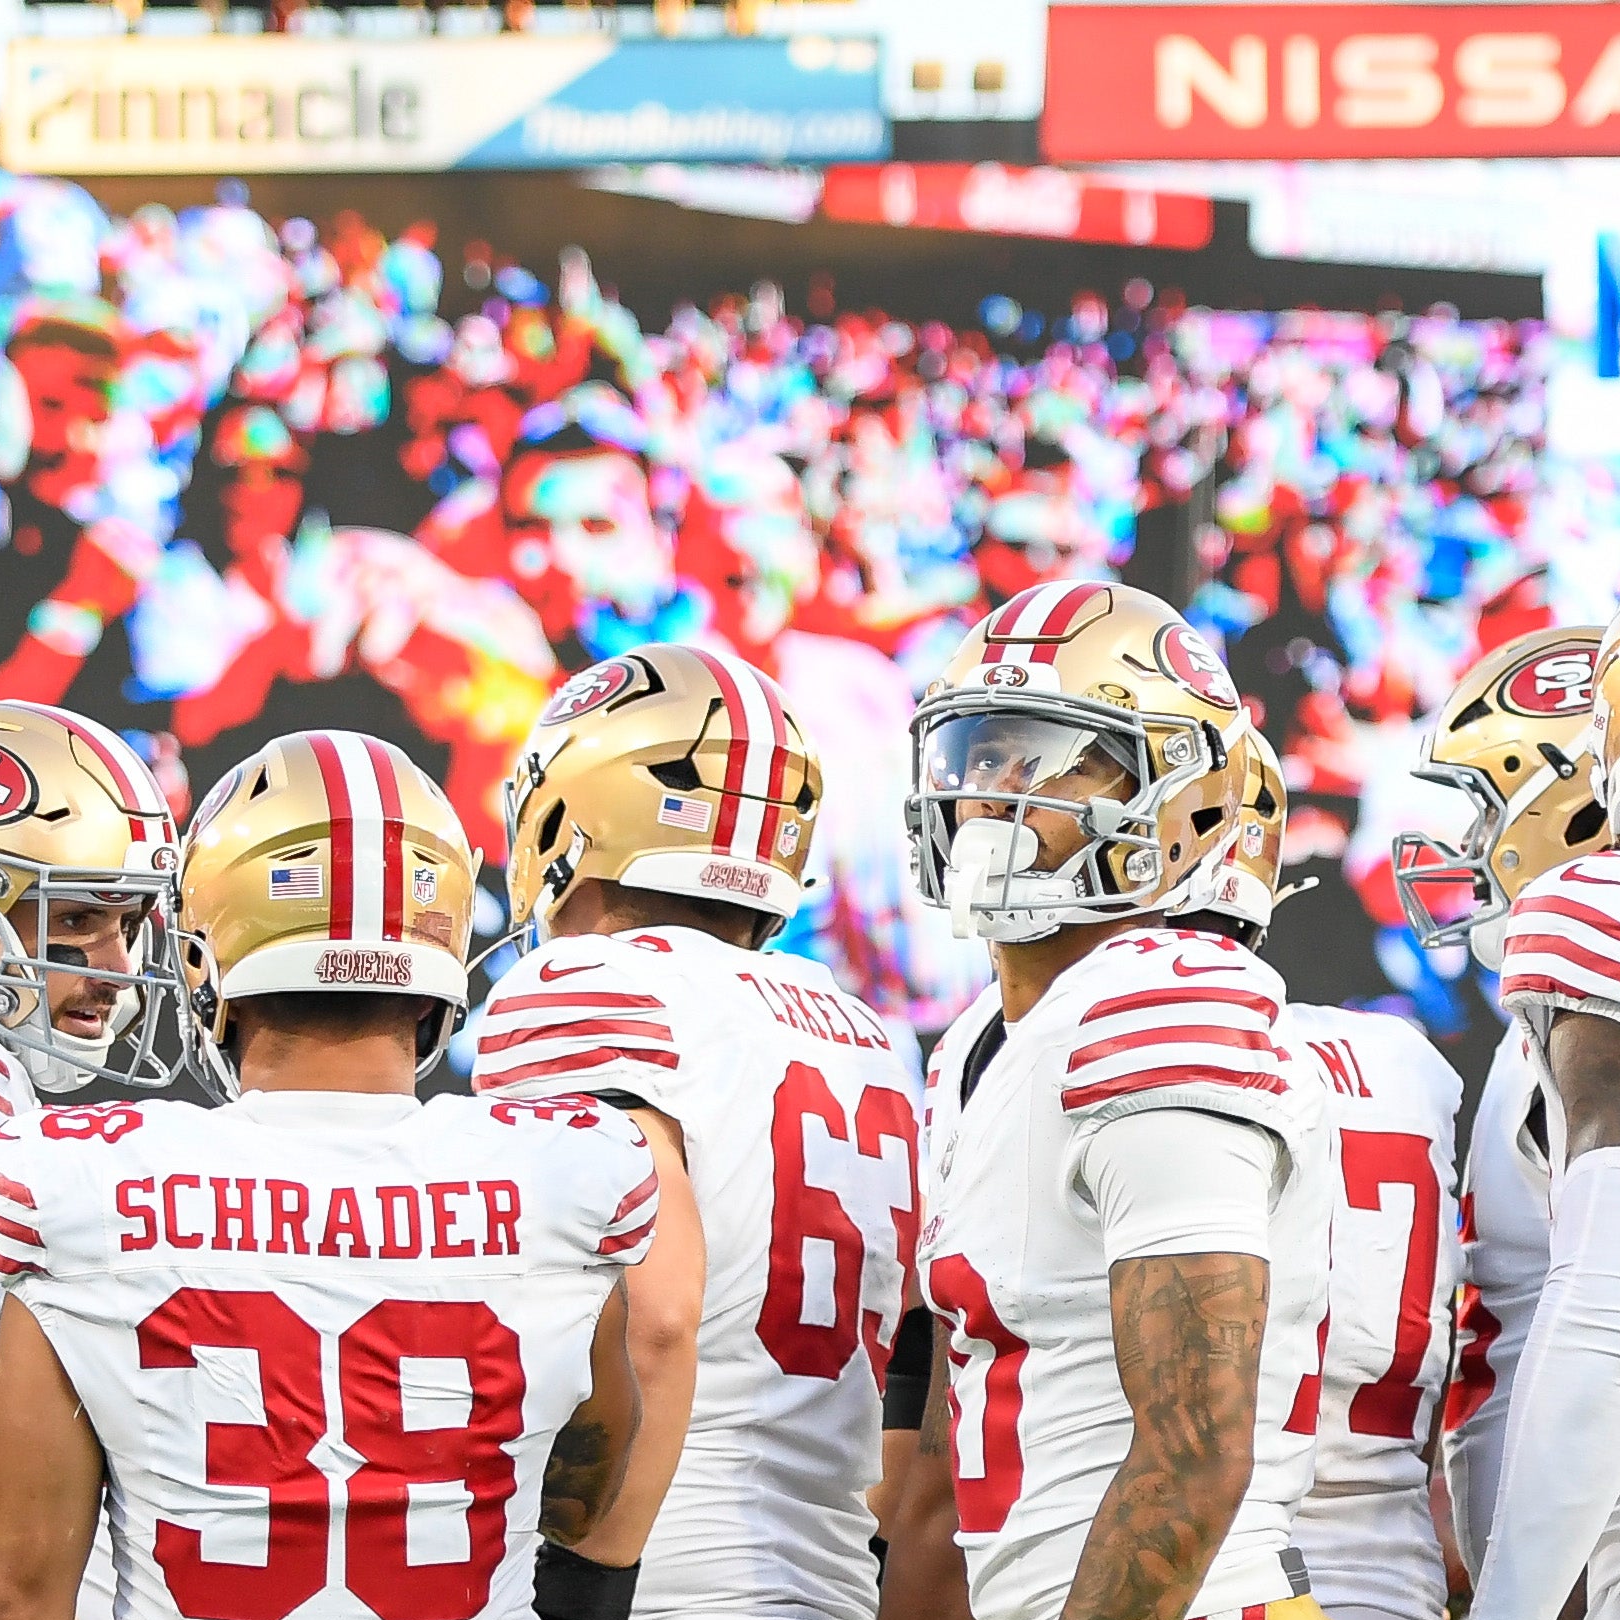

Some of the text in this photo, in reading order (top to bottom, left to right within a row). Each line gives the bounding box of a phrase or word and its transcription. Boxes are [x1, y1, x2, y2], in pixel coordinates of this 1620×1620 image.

[314, 949, 414, 986] 49ERS
[115, 1173, 522, 1260] SCHRADER
[755, 1060, 920, 1400] 63
[927, 1252, 1030, 1533] 0
